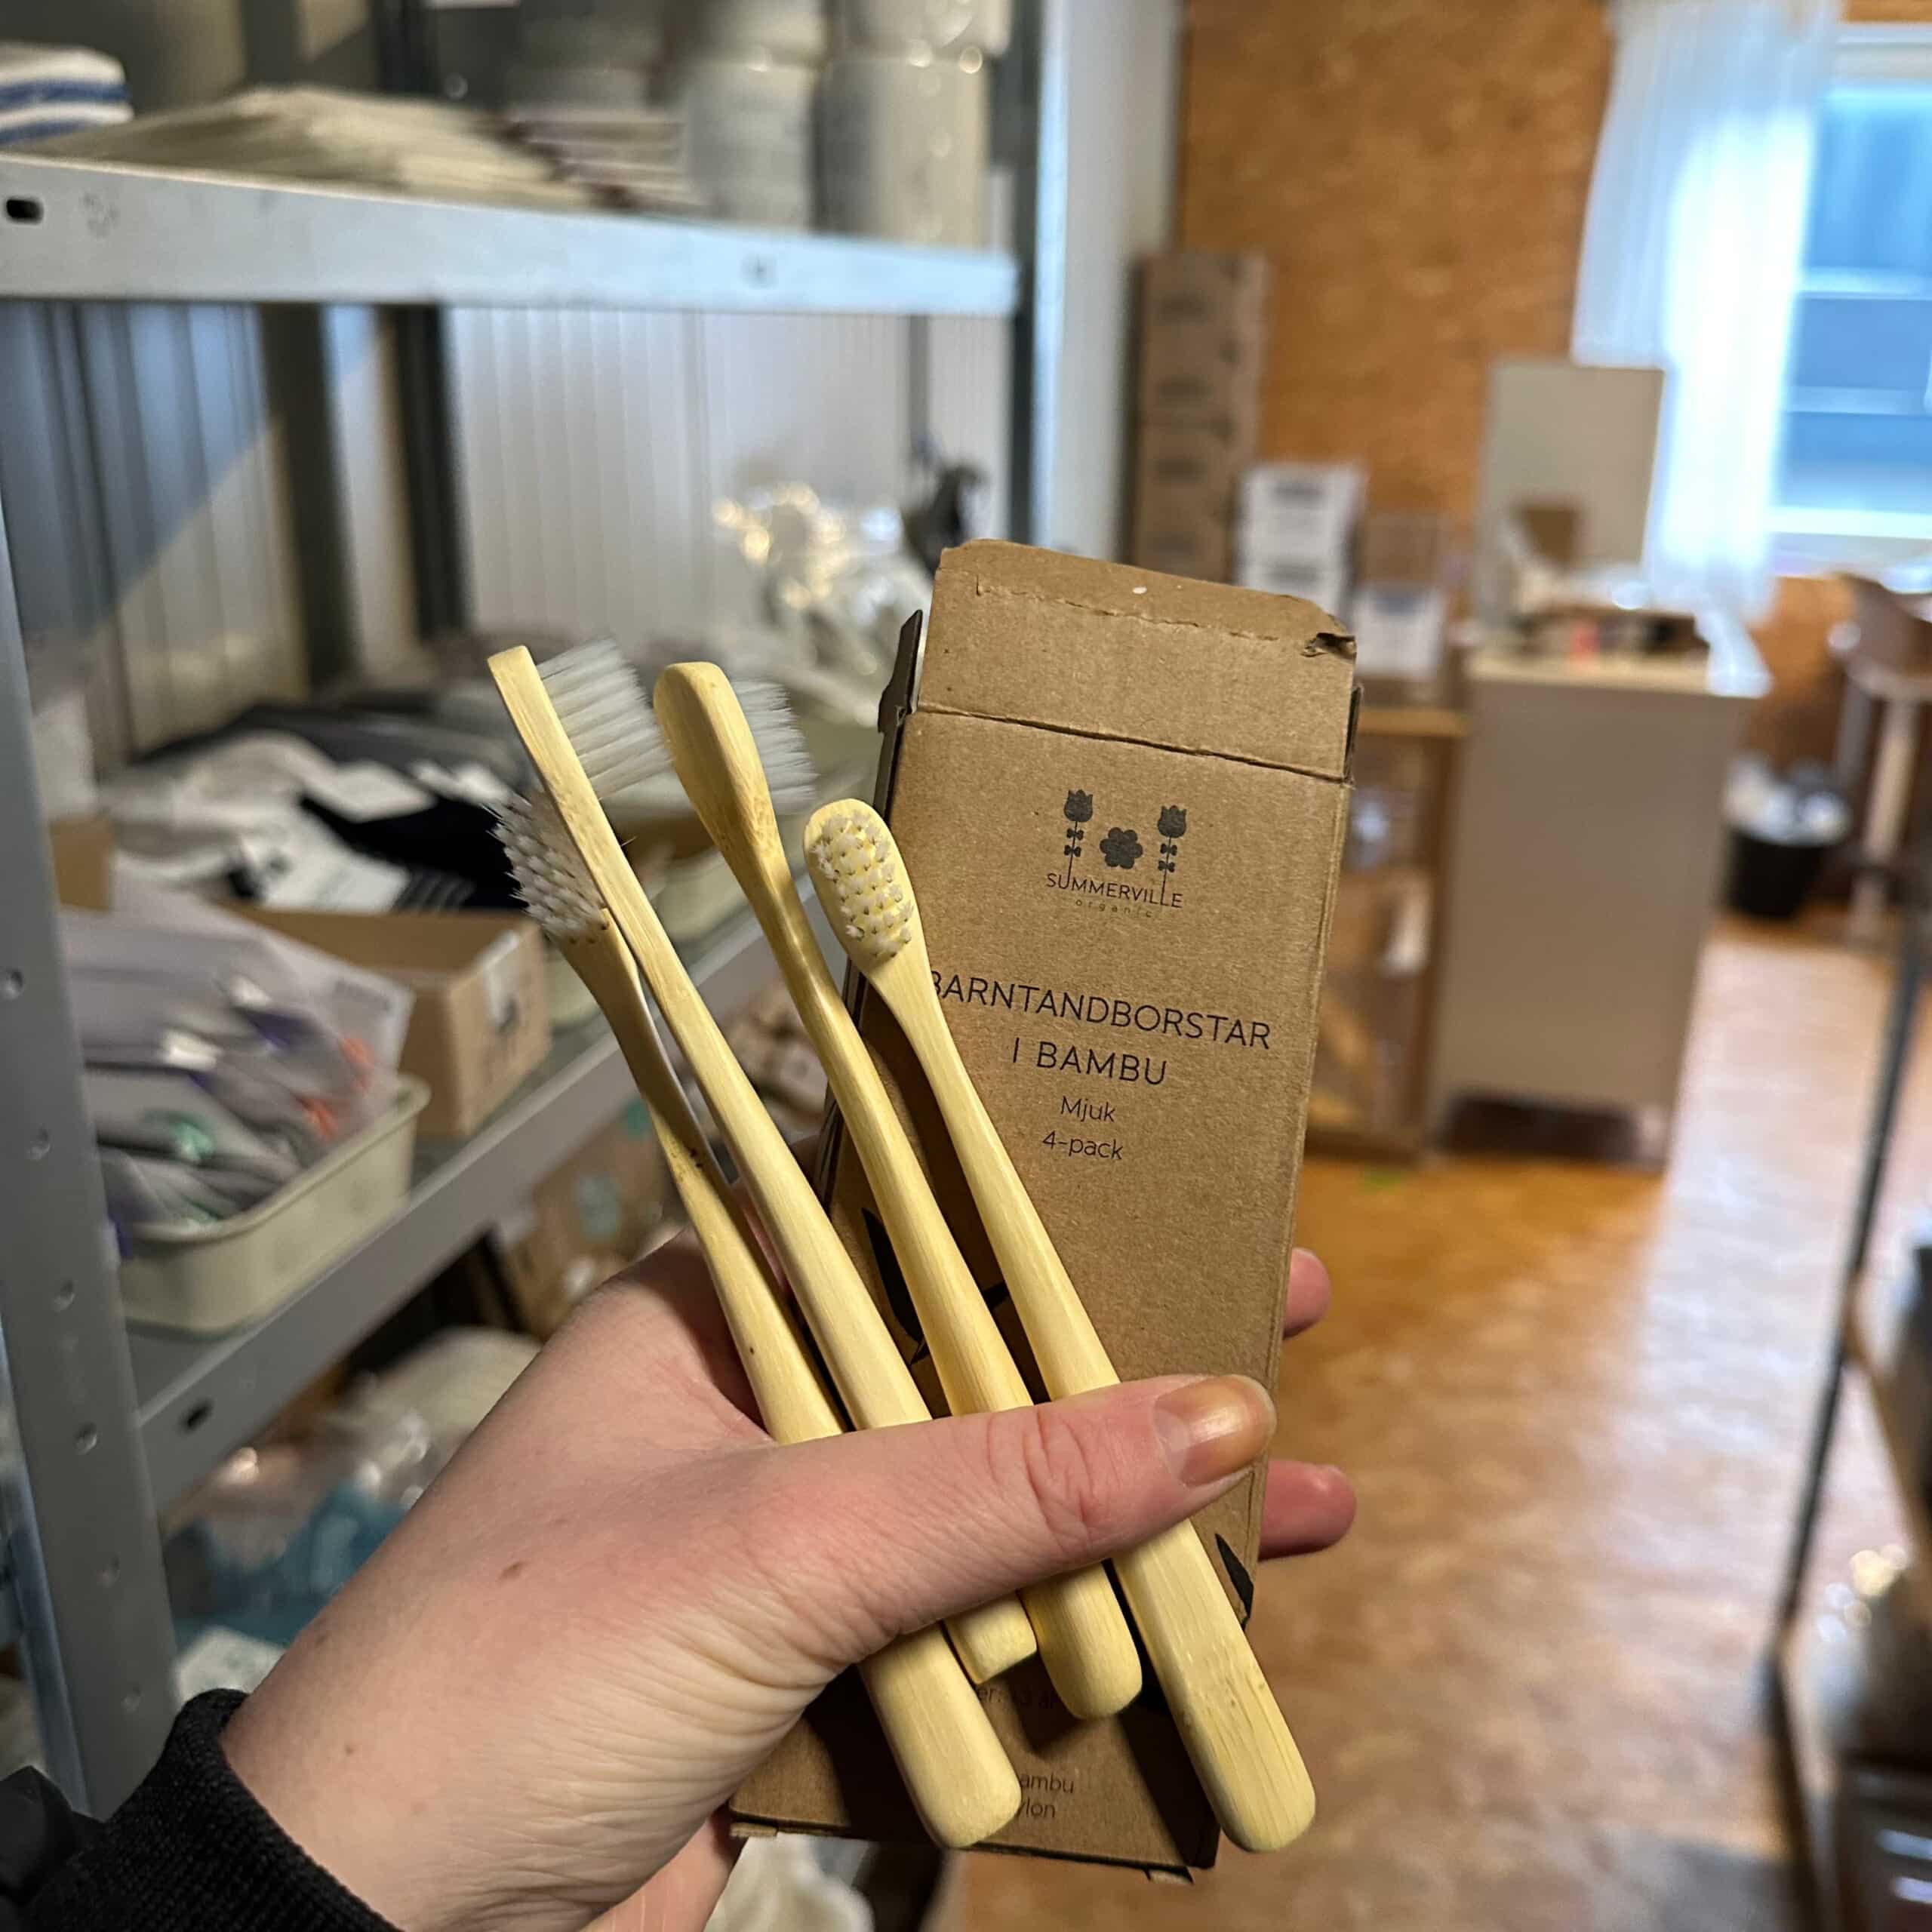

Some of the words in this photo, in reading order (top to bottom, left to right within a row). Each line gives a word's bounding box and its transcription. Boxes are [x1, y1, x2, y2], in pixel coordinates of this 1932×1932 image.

[1047, 872, 1183, 908] SUMMERVILLE
[1075, 899, 1154, 918] organic
[1013, 1037, 1020, 1063] I
[1036, 1041, 1167, 1085] BAMBU
[1060, 1095, 1116, 1122] Mjuk
[1041, 1130, 1124, 1160] 4-pack
[1019, 1772, 1075, 1795] ambu
